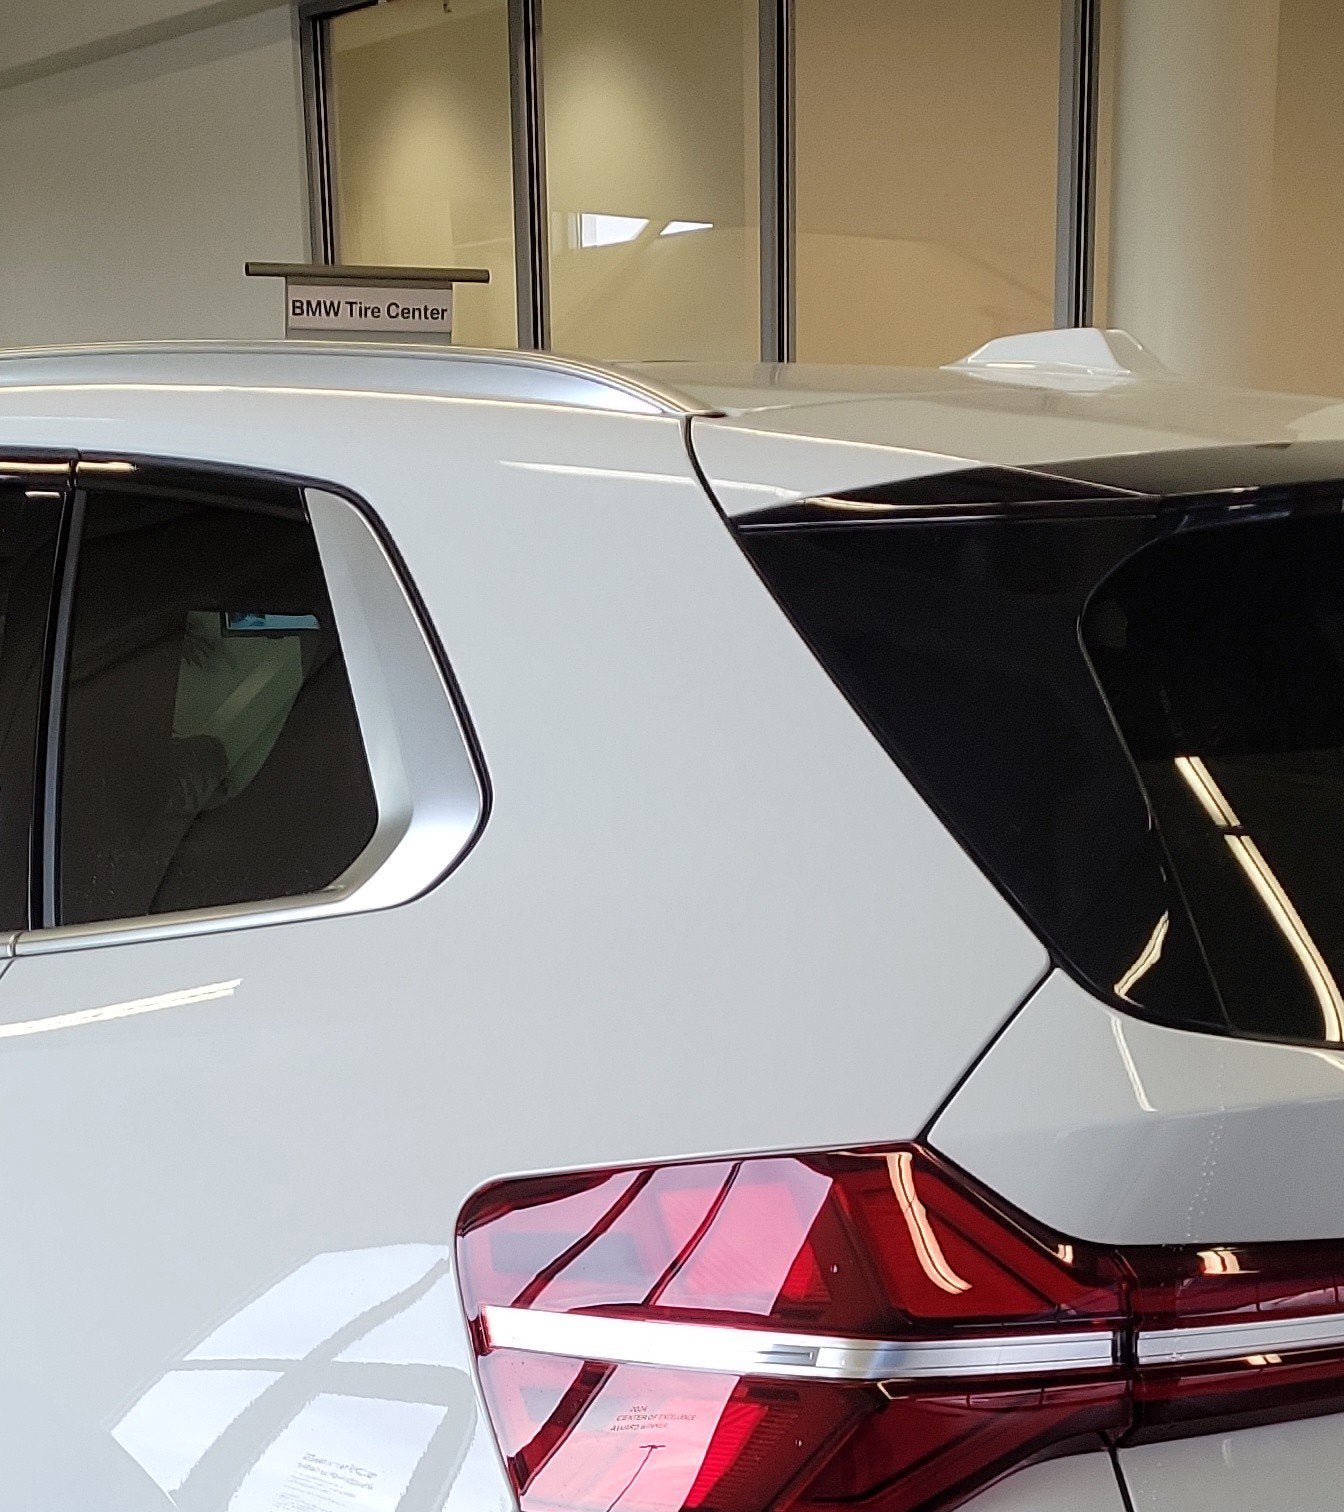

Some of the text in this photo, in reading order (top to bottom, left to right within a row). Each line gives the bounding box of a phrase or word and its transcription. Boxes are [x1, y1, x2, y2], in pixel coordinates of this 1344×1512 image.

[291, 299, 448, 321] BMW Tire Center
